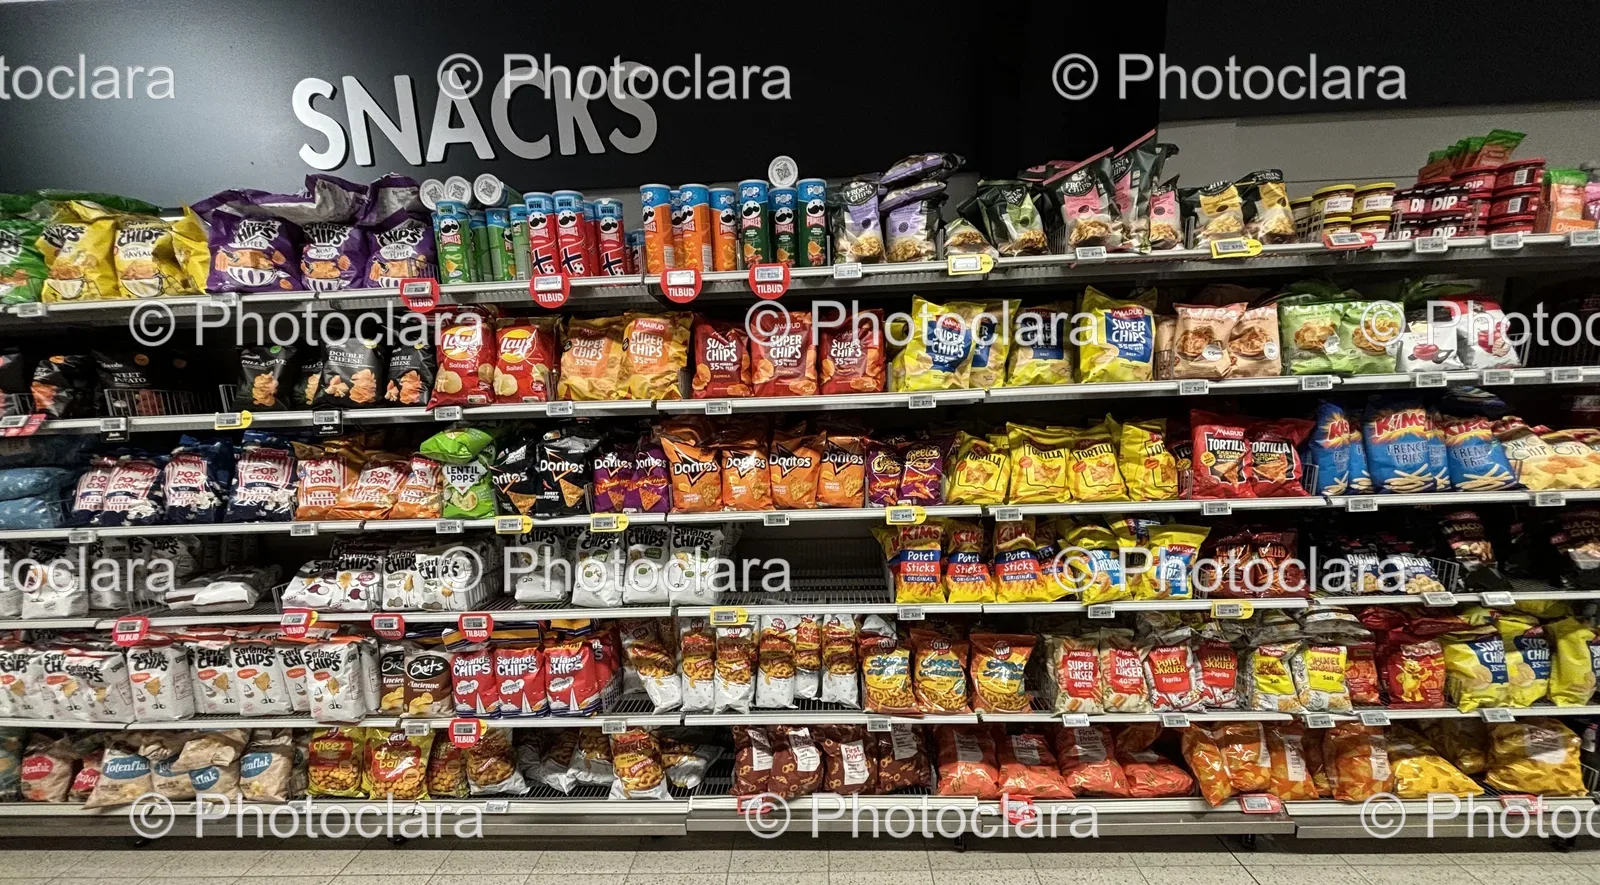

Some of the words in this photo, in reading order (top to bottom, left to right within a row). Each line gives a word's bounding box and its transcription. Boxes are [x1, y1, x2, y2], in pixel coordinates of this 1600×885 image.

[292, 61, 658, 171] SNACKS
[1466, 180, 1484, 189] DIP
[1432, 195, 1458, 210] DIP
[667, 287, 695, 297] TILBUD
[756, 284, 784, 293] TILBUD
[537, 293, 564, 302] TILBUD
[1112, 308, 1143, 318] MAARUD
[636, 321, 664, 331] MAARUD
[1112, 320, 1145, 331] SUPER
[630, 333, 663, 346] SUPER
[1112, 330, 1146, 344] CHIPS
[574, 338, 605, 349] SUPER
[832, 338, 861, 350] SUPER
[329, 351, 364, 359] DOUBLE
[572, 347, 603, 360] CHIPS
[630, 344, 662, 358] CHIPS
[706, 348, 738, 362] CHIPS
[770, 345, 802, 359] CHIPS
[830, 348, 862, 358] CHIPS
[932, 341, 965, 358] CHIPS
[328, 356, 363, 365] CHEESE
[710, 362, 720, 370] 35
[505, 364, 524, 372] Salted
[1026, 444, 1064, 460] TORTILLA
[769, 454, 812, 468] Doritos
[822, 451, 863, 465] Doritos
[1396, 453, 1424, 464] FRIES
[252, 467, 277, 476] POP
[446, 465, 480, 476] LENTIL
[540, 459, 584, 474] Doritos
[674, 460, 717, 475] Doritos
[177, 471, 201, 479] POP
[248, 474, 278, 482] CORN
[310, 469, 333, 477] POP
[450, 474, 476, 483] POPS
[310, 475, 336, 484] CORN
[627, 533, 667, 548] CHIPS
[673, 534, 714, 550] CHIPS
[908, 551, 934, 561] Potet
[1005, 550, 1031, 560] Potet
[339, 557, 379, 572] CHIPS
[385, 558, 416, 573] CHIPS
[906, 562, 936, 573] Sticks
[955, 564, 982, 574] Sticks
[1003, 561, 1034, 572] Sticks
[286, 626, 306, 634] TILBUD
[464, 629, 488, 637] TILBUD
[727, 627, 741, 636] OLW
[880, 638, 896, 648] OLW
[934, 640, 949, 649] OLW
[995, 645, 1010, 654] OLW
[235, 652, 275, 668] CHIPS
[1115, 656, 1142, 667] SUPER
[1157, 657, 1181, 667] POTET
[1207, 653, 1233, 663] POTET
[306, 656, 342, 673] CHIPS
[453, 663, 491, 677] CHIPS
[496, 663, 538, 677] CHIPS
[1067, 661, 1094, 671] SUPER
[1154, 664, 1187, 675] SKRUER
[1204, 660, 1236, 670] SKRUER
[454, 736, 476, 744] TILBUD
[314, 741, 345, 752] cheez
[845, 746, 861, 754] First
[630, 758, 653, 773] ORIGINAL
